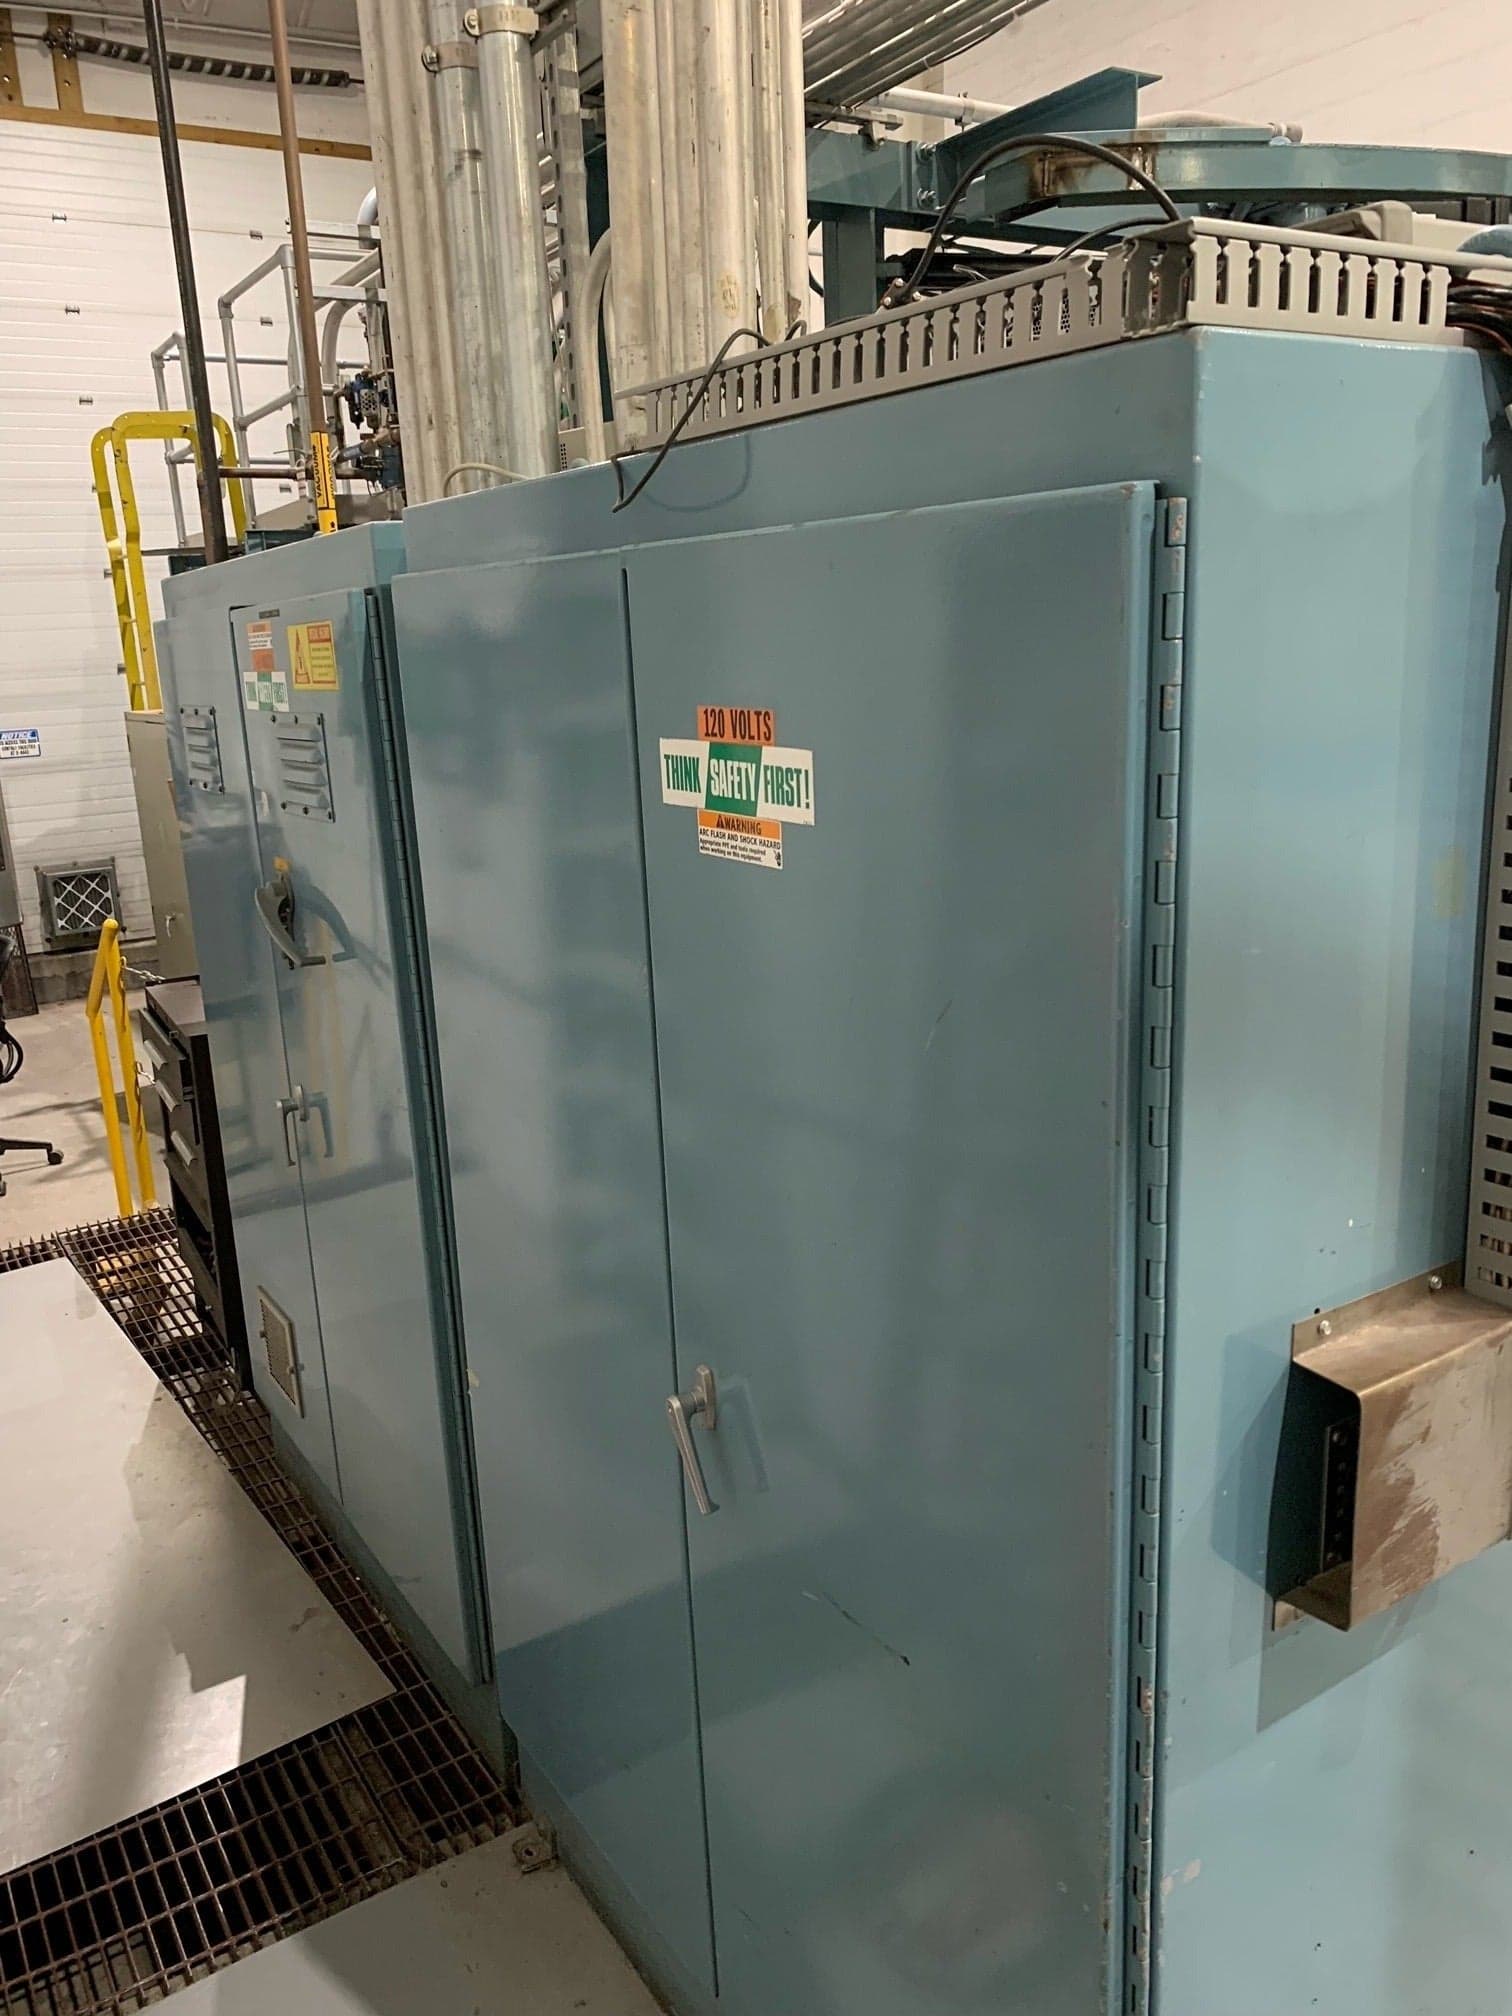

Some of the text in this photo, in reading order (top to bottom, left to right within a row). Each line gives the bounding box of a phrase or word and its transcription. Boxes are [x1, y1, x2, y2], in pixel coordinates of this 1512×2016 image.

[704, 708, 771, 741] 120 VOLTS
[664, 754, 810, 809] THINK SAFETY FIRST!
[700, 828, 780, 850] ARC FLASH AND SHOCK HAZARD
[724, 817, 761, 835] WARNING
